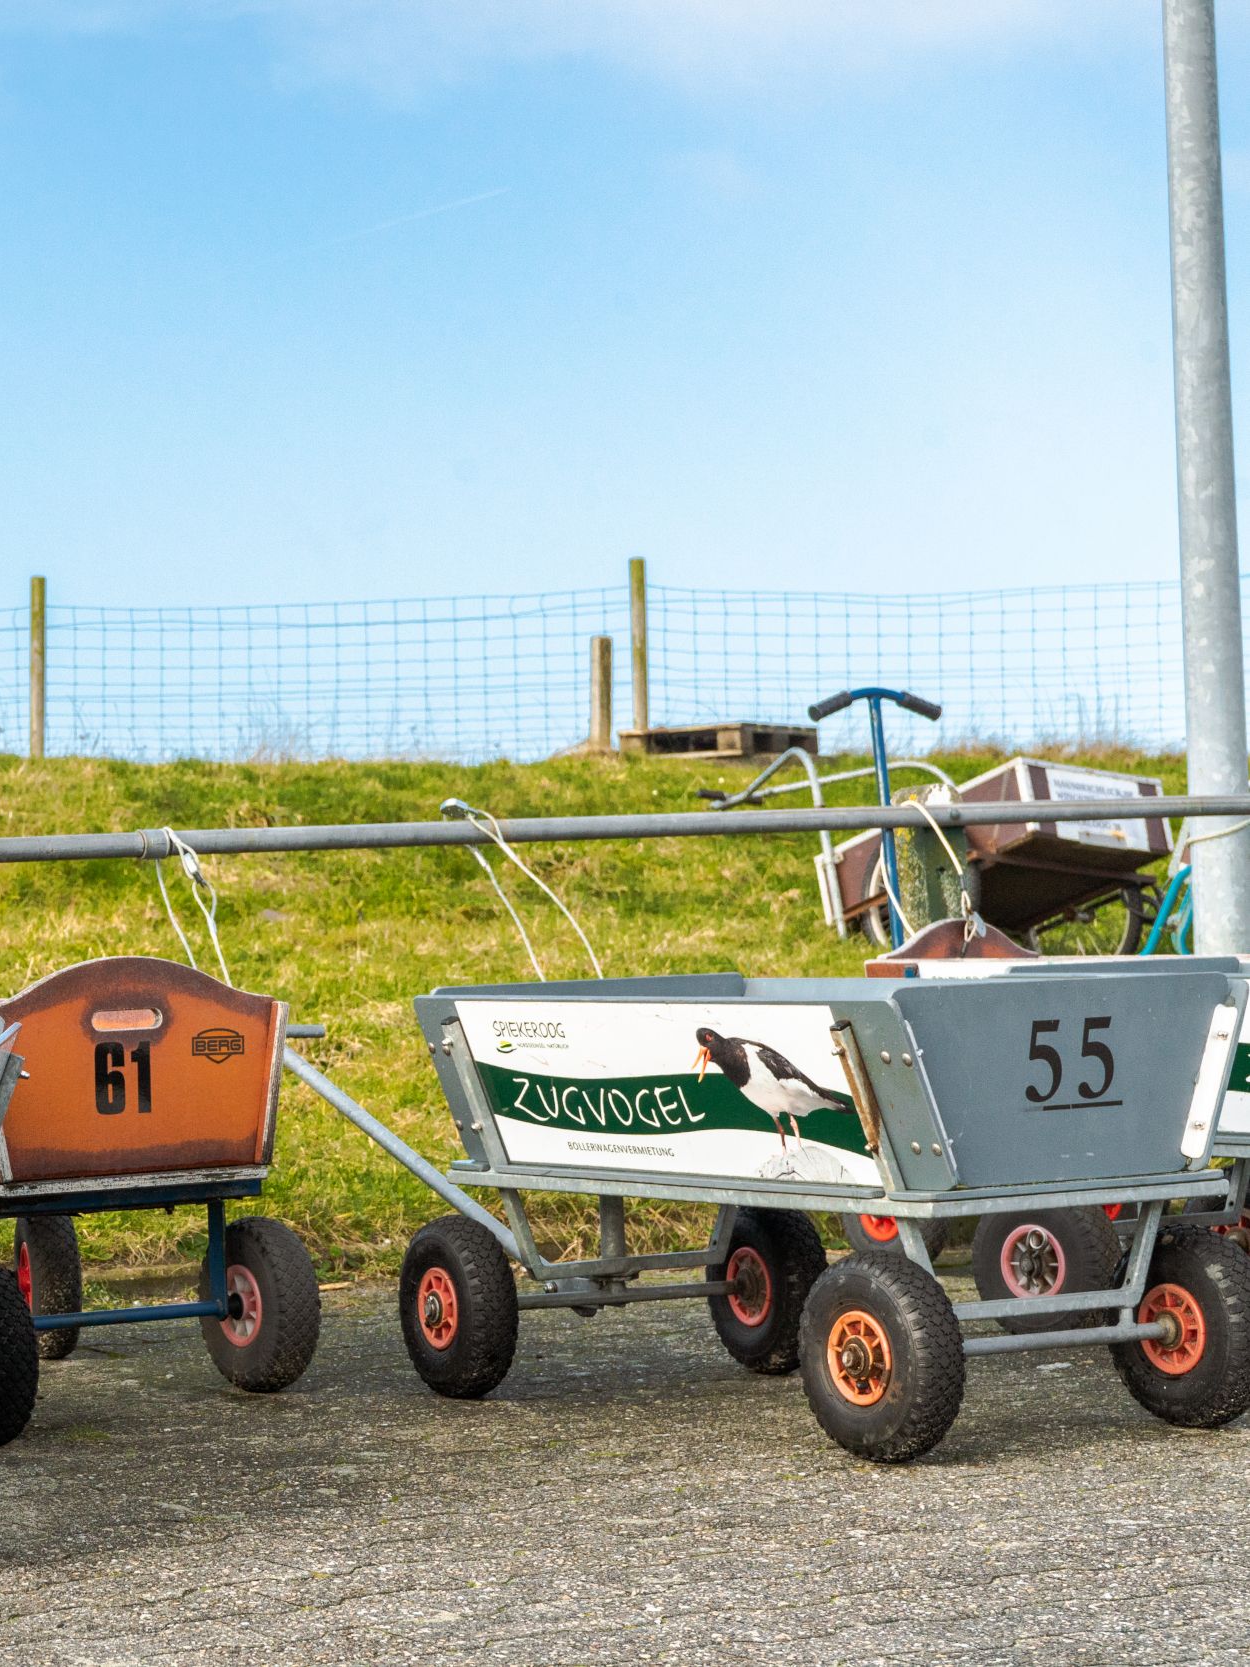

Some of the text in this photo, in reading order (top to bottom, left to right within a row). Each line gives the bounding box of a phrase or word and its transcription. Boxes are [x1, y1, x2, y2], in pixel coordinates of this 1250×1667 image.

[195, 1039, 242, 1053] BERG
[492, 1020, 566, 1039] SPIEKEROOG
[1025, 1016, 1114, 1103] 55
[95, 1040, 152, 1115] 61
[512, 1077, 706, 1128] ZUGVOGEL
[567, 1141, 675, 1157] BOLLERWAGENVERMIETUNG
